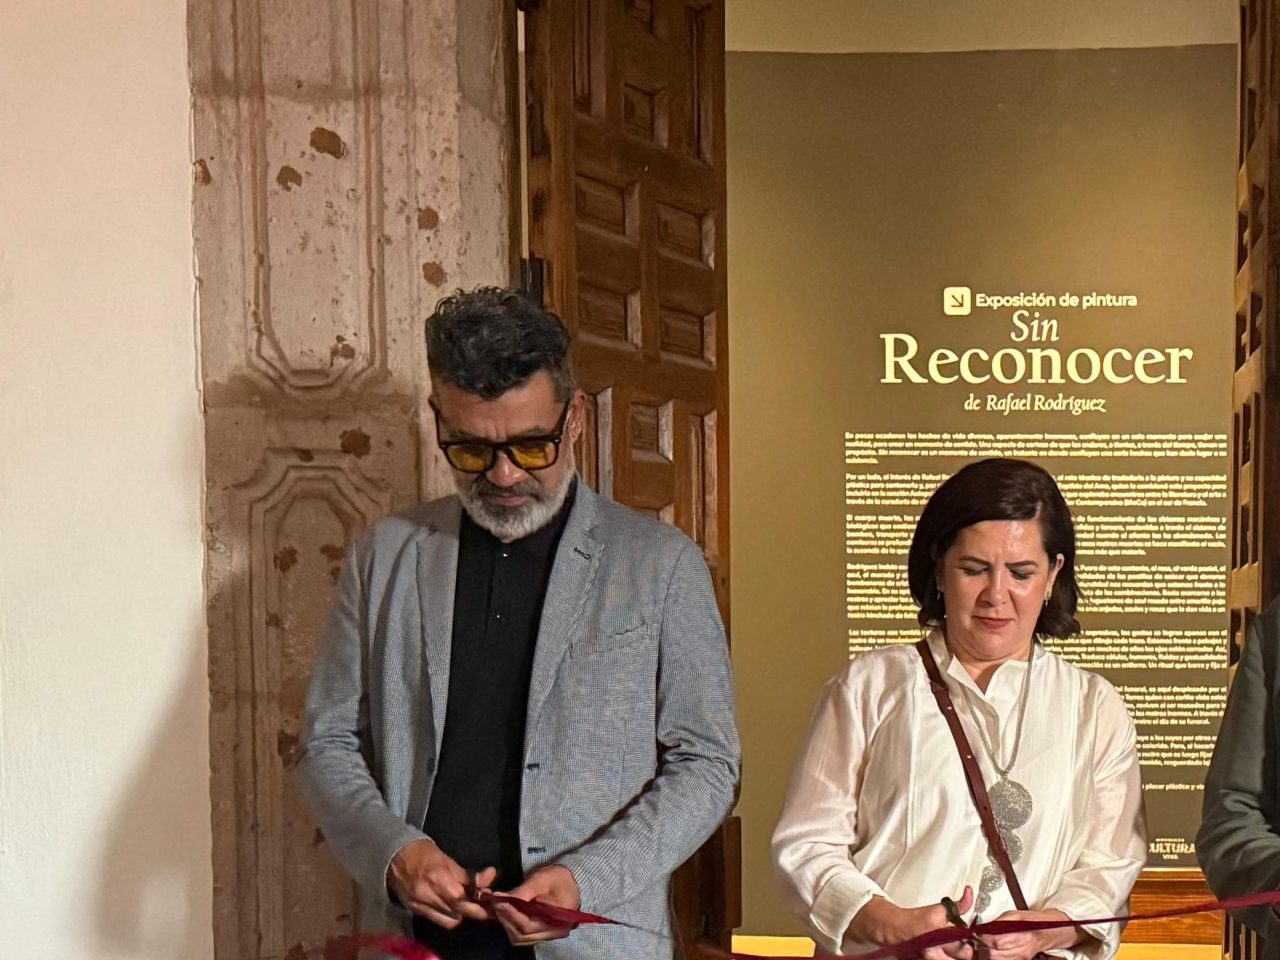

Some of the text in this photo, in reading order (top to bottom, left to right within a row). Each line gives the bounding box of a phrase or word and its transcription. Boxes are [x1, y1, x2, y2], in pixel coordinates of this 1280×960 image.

[976, 292, 1138, 309] Exposición de pintura
[1010, 310, 1060, 342] Sin
[879, 332, 1194, 385] Reconocer
[964, 393, 1107, 416] de Rafael Rodríguez
